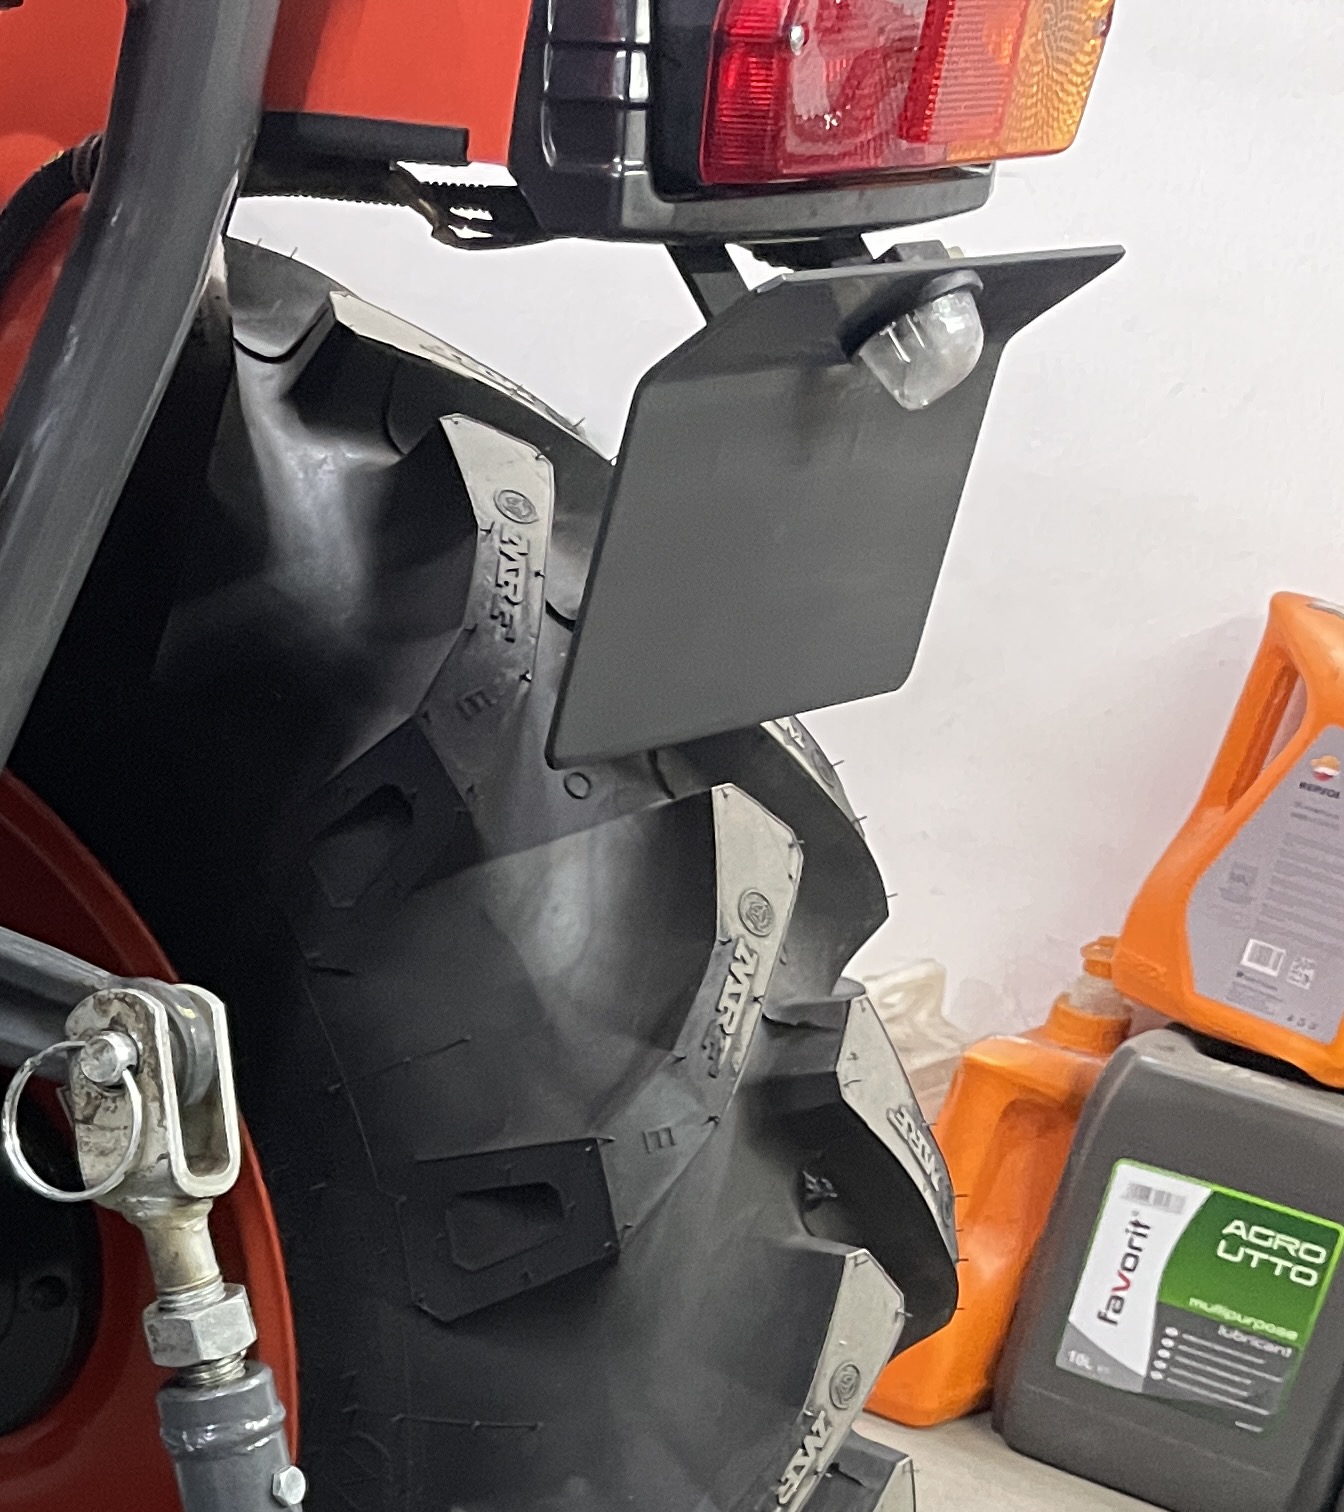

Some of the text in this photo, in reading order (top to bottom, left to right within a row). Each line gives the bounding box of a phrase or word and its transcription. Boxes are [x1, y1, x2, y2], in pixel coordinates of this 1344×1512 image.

[701, 935, 760, 1079] MRF
[886, 1104, 942, 1193] MRF
[1096, 1216, 1153, 1327] favorit
[1216, 1239, 1319, 1288] UTTO
[1221, 1219, 1328, 1265] AGRO
